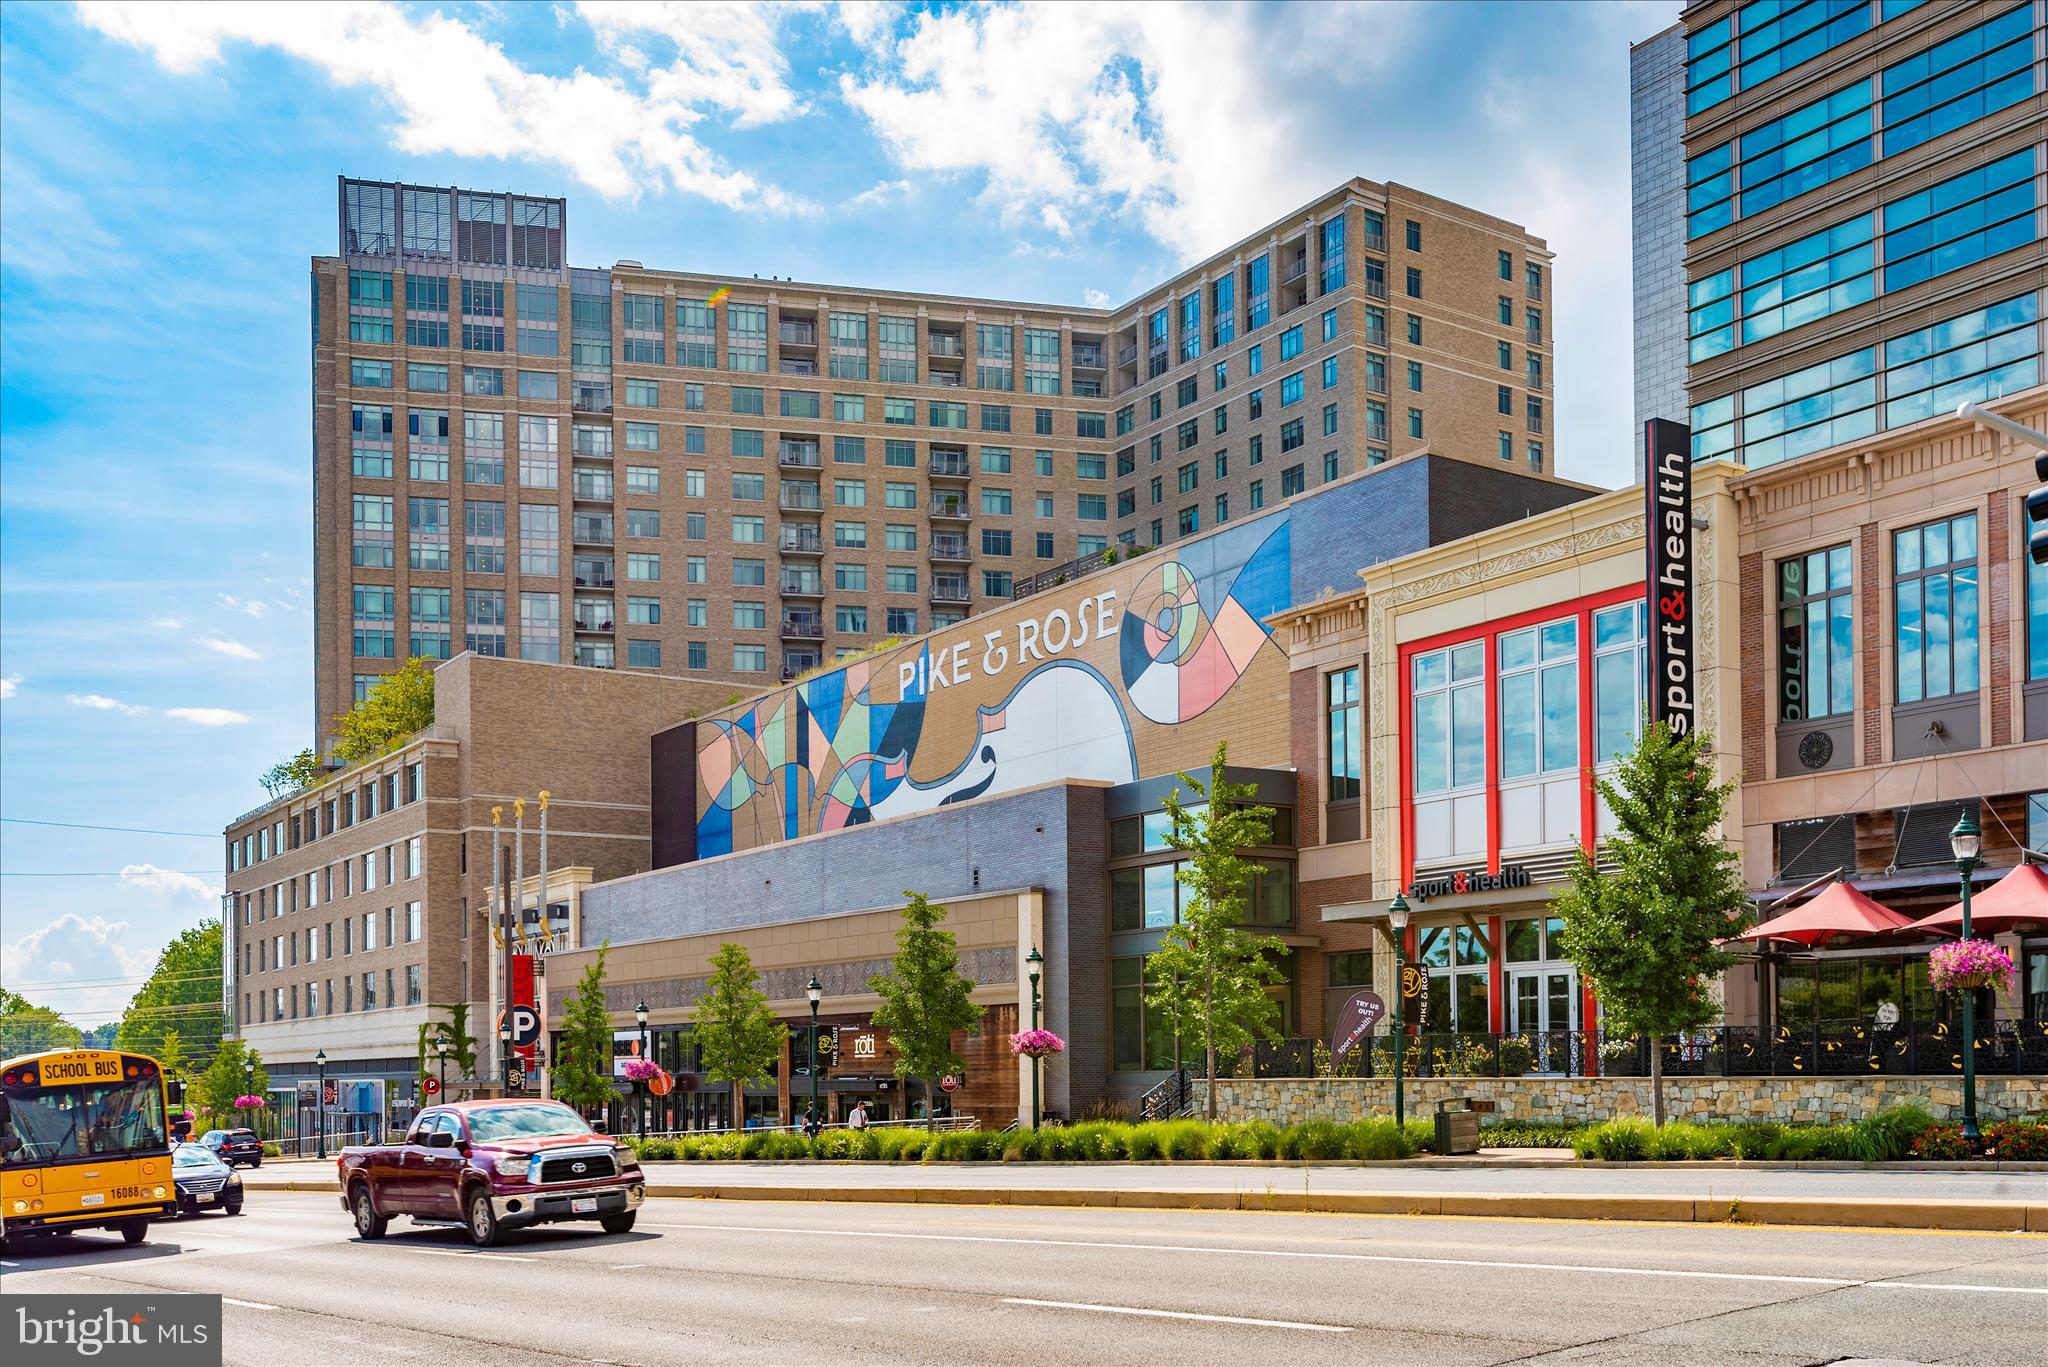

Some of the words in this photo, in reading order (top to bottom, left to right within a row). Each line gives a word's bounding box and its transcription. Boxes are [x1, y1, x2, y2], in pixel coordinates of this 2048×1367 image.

[1658, 452, 1693, 737] sport&health
[899, 640, 972, 702] PIKE
[982, 629, 1009, 676] &
[1016, 590, 1119, 665] ROSE
[1408, 866, 1529, 903] sport&health
[1421, 966, 1429, 991] ROSE
[1356, 999, 1369, 1007] TRY
[1370, 1002, 1380, 1010] US
[1421, 991, 1429, 1000] &
[1358, 1007, 1375, 1017] OUT!
[1420, 1001, 1428, 1023] PIKE
[513, 1011, 535, 1041] P
[45, 1062, 91, 1079] SCHOOL
[95, 1061, 118, 1076] BUS
[429, 1081, 436, 1089] P
[110, 1186, 139, 1200] 16088
